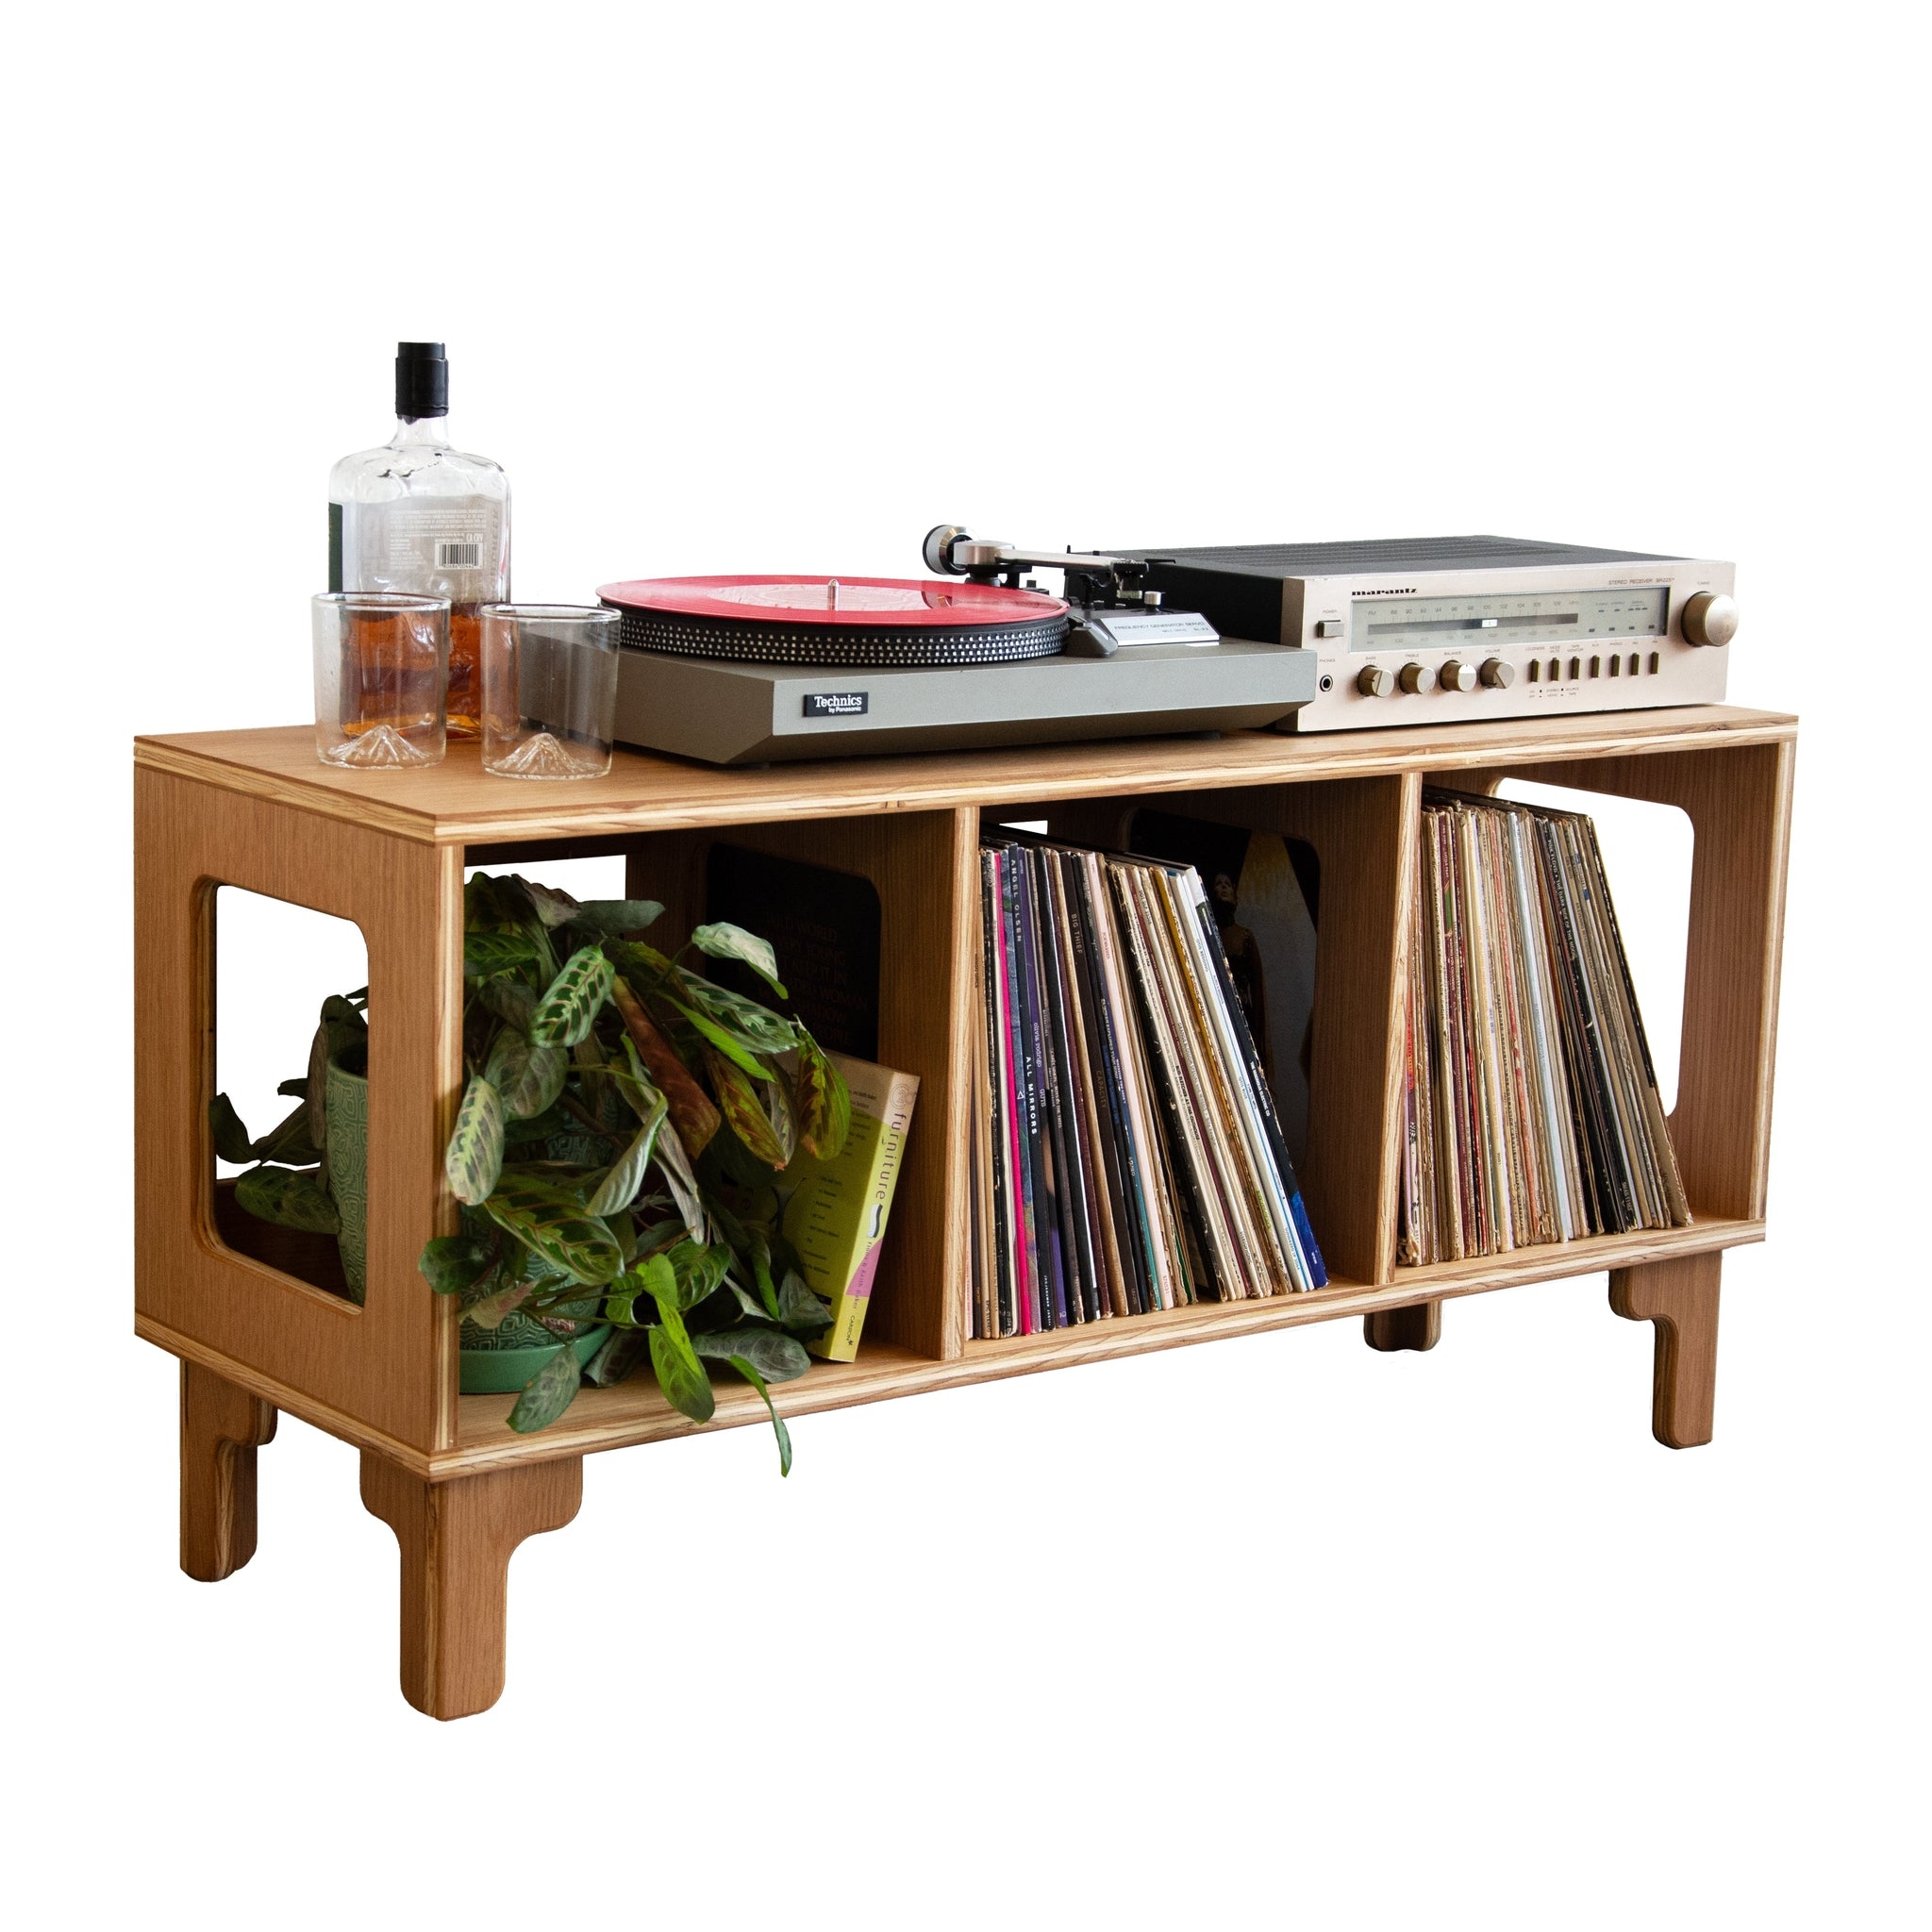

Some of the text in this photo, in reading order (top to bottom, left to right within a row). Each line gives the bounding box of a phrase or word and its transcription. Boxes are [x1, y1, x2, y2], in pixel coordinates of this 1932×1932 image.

[1352, 588, 1417, 597] marantz
[814, 694, 862, 708] Technics
[797, 921, 837, 942] WORLD
[1199, 950, 1208, 972] REDDING
[1588, 958, 1596, 981] HANCOCK
[1074, 930, 1082, 954] THIEF
[1095, 1070, 1106, 1108] CAPACITY
[1034, 1042, 1042, 1067] rodrigo
[1176, 1022, 1186, 1042] ORANGE
[1182, 1042, 1192, 1064] BLOSSOM
[1027, 1084, 1036, 1134] MIRRORS
[1178, 1075, 1187, 1097] FLETCHER
[1190, 1115, 1199, 1141] OUTHOUSE
[1258, 1091, 1268, 1109] ELECTRIC
[874, 1111, 907, 1201] furniture
